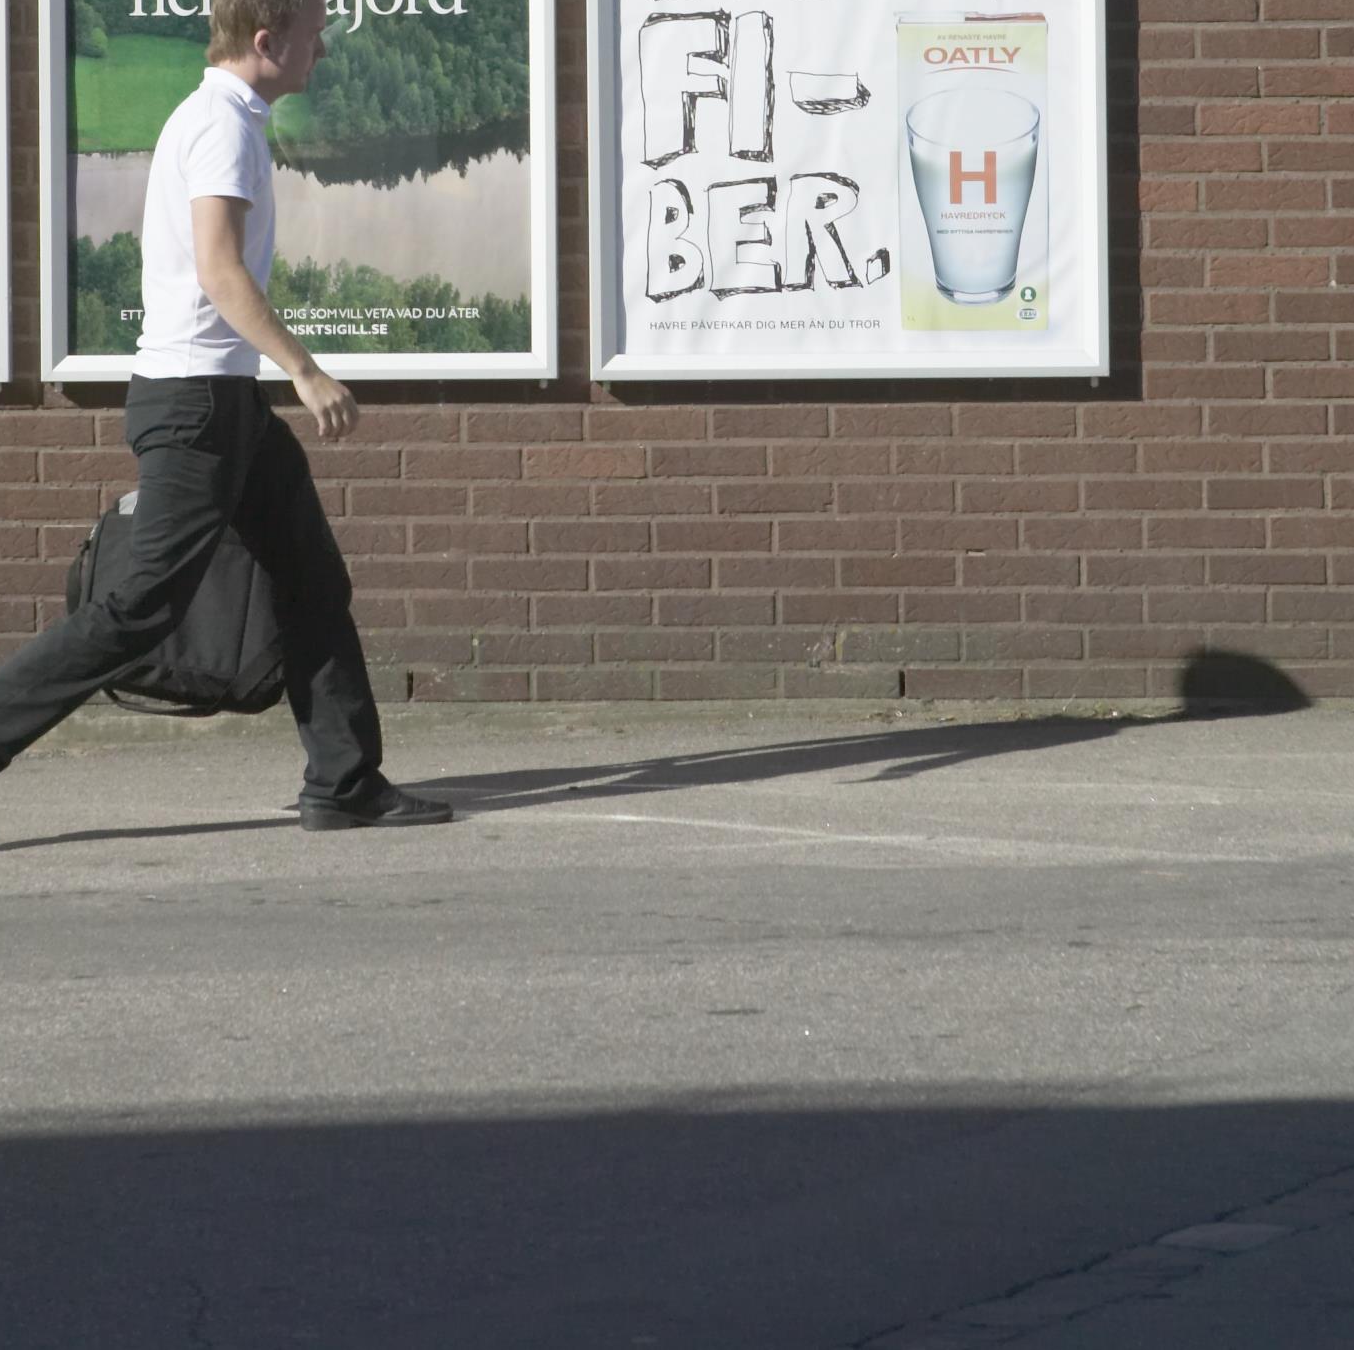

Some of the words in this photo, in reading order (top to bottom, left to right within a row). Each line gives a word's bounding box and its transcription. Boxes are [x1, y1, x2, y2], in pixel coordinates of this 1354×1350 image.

[923, 47, 1021, 64] OATLY
[639, 8, 871, 169] FI-
[949, 151, 997, 204] H
[941, 211, 1006, 219] HAVREDRYCK
[645, 172, 890, 303] BER.
[121, 309, 143, 320] ETT
[284, 308, 307, 319] DIG
[310, 308, 337, 319] SOM
[339, 308, 363, 319] VILL
[364, 308, 395, 319] VETA
[396, 308, 422, 319] VAD
[426, 308, 445, 319] DU
[449, 306, 480, 319] ÄTER
[286, 324, 388, 335] NSKTSIGILL.SE
[650, 321, 687, 330] HAVRE
[691, 319, 752, 330] PÅVERKAR
[756, 321, 776, 330] DIG
[780, 321, 805, 329] MER
[809, 318, 825, 329] ÄN
[829, 320, 845, 329] DU
[849, 320, 881, 329] TROR
